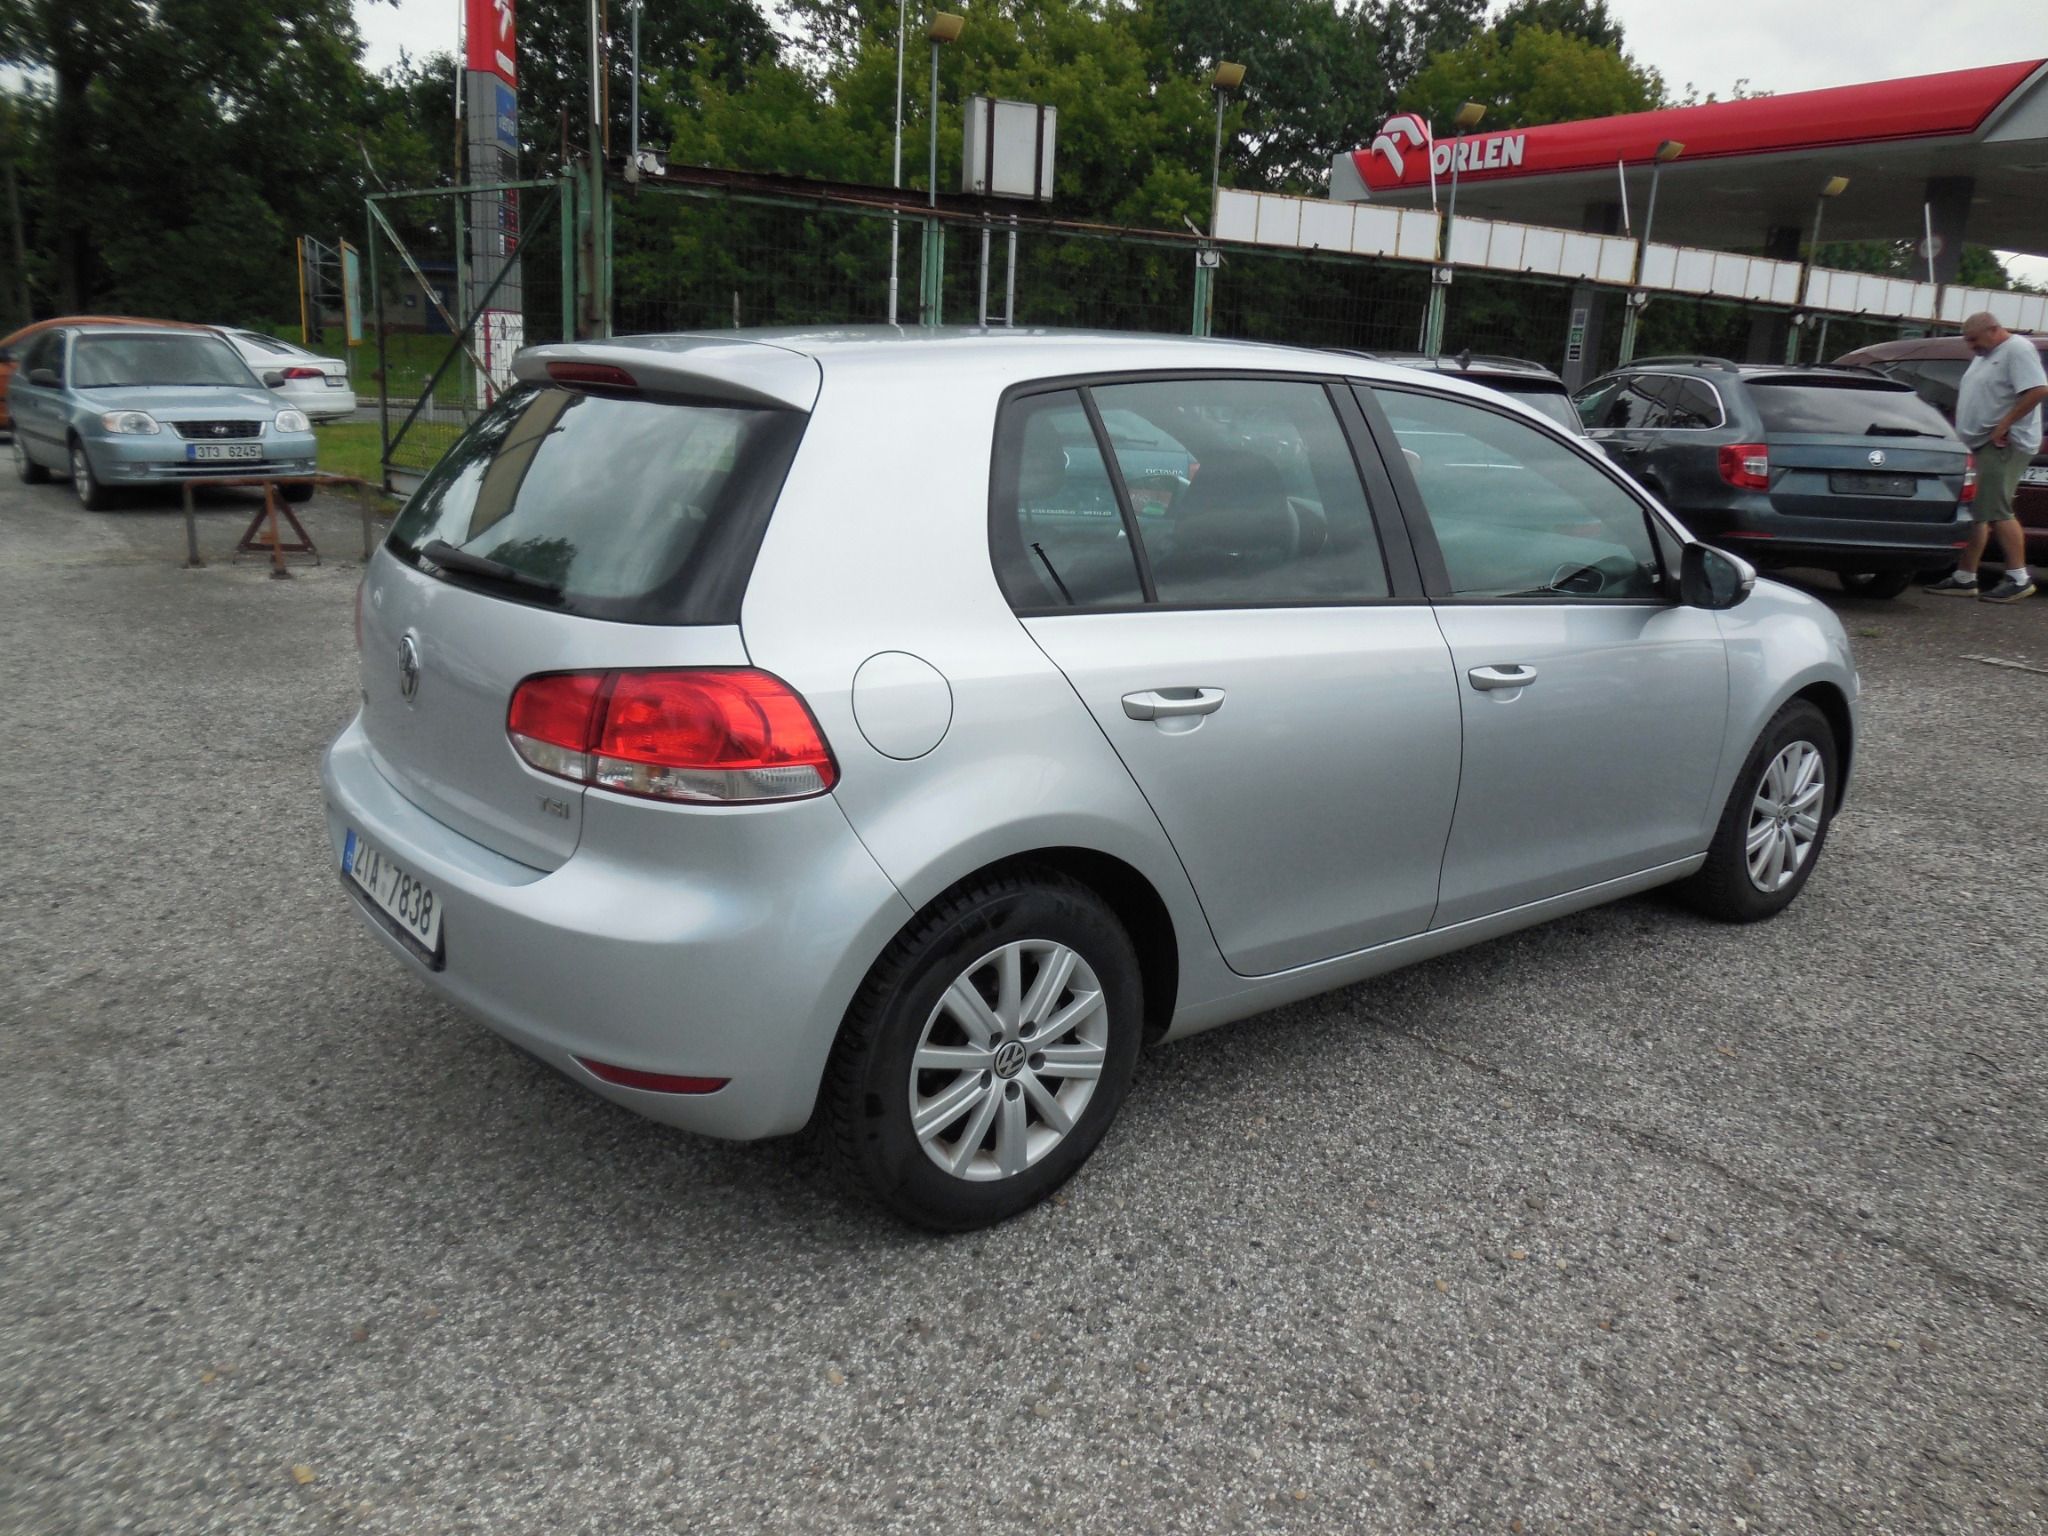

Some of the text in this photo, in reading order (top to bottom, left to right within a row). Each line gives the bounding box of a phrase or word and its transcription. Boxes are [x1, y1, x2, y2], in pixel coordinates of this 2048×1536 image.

[1432, 134, 1525, 175] ORLEN
[197, 446, 257, 458] 3T3 6245
[387, 866, 433, 936] 7838
